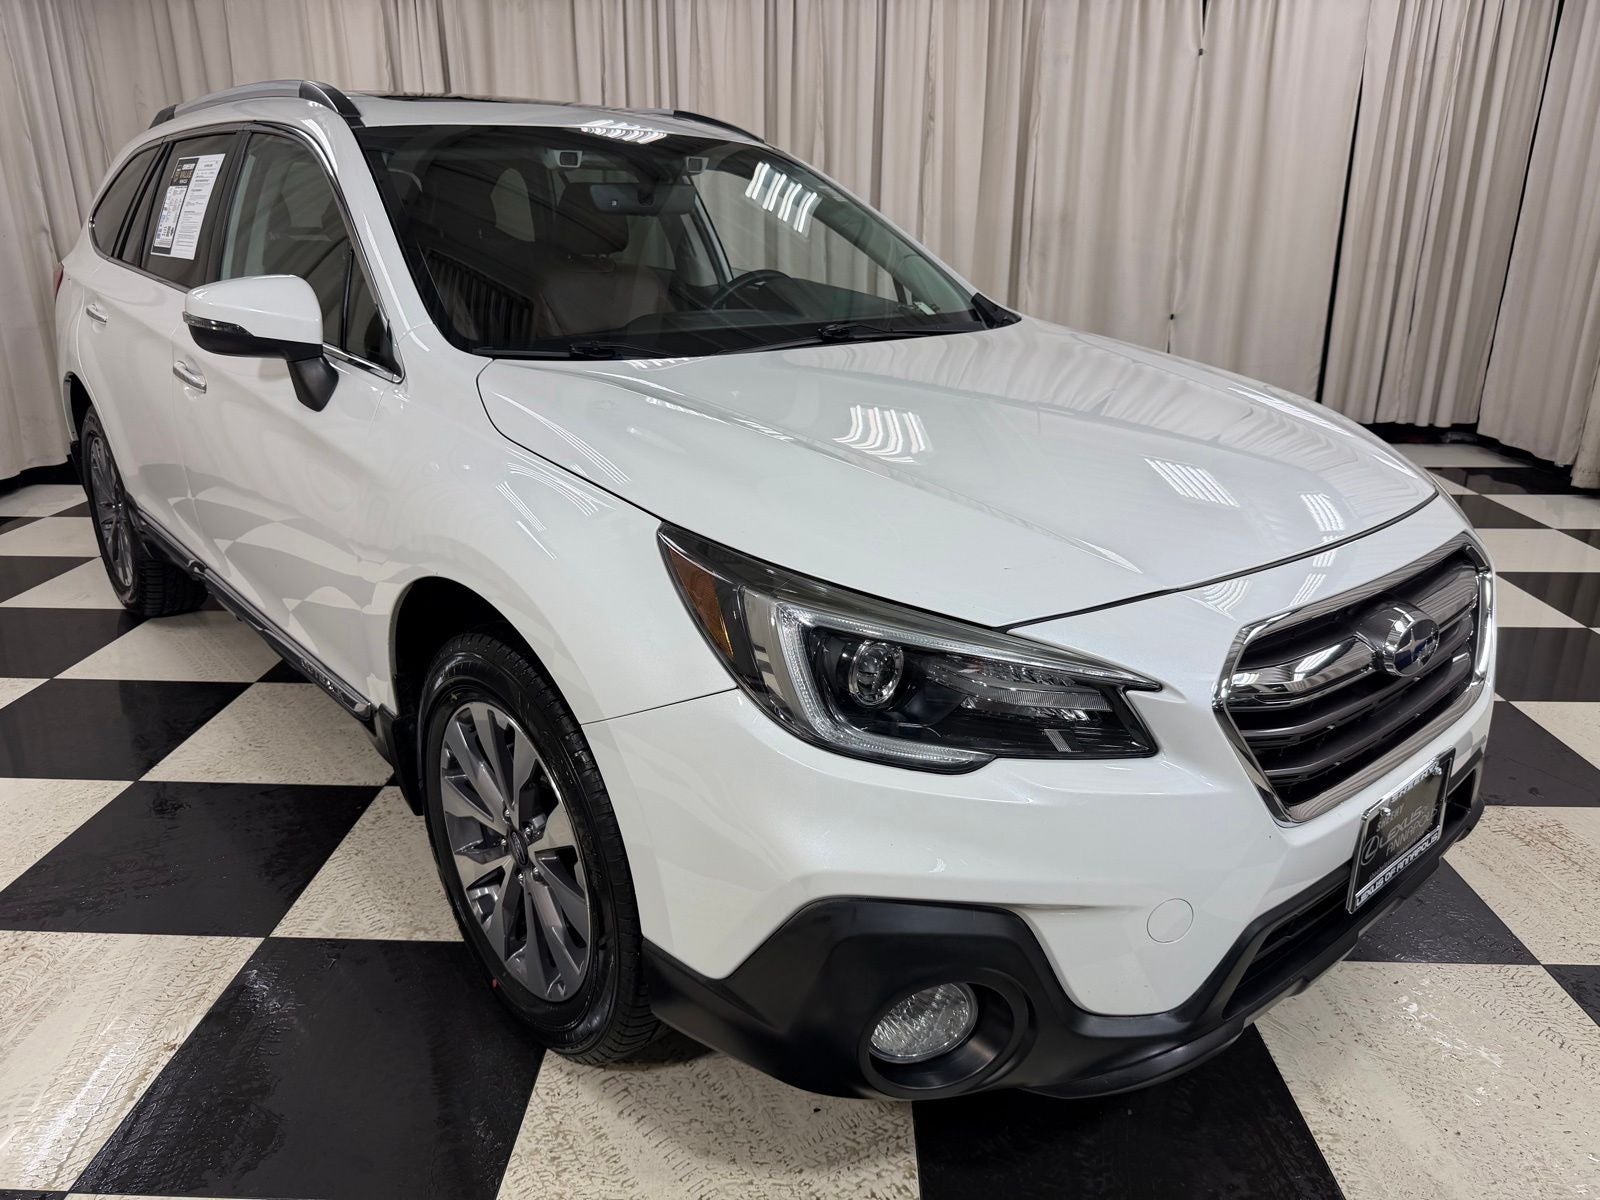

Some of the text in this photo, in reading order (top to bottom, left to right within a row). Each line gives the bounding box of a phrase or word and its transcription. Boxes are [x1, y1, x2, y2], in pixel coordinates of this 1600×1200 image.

[1379, 806, 1424, 849] LEXUS
[1356, 877, 1384, 907] LEXUS
[1385, 868, 1397, 883] OF
[1397, 831, 1439, 872] ANNAPOLIS
